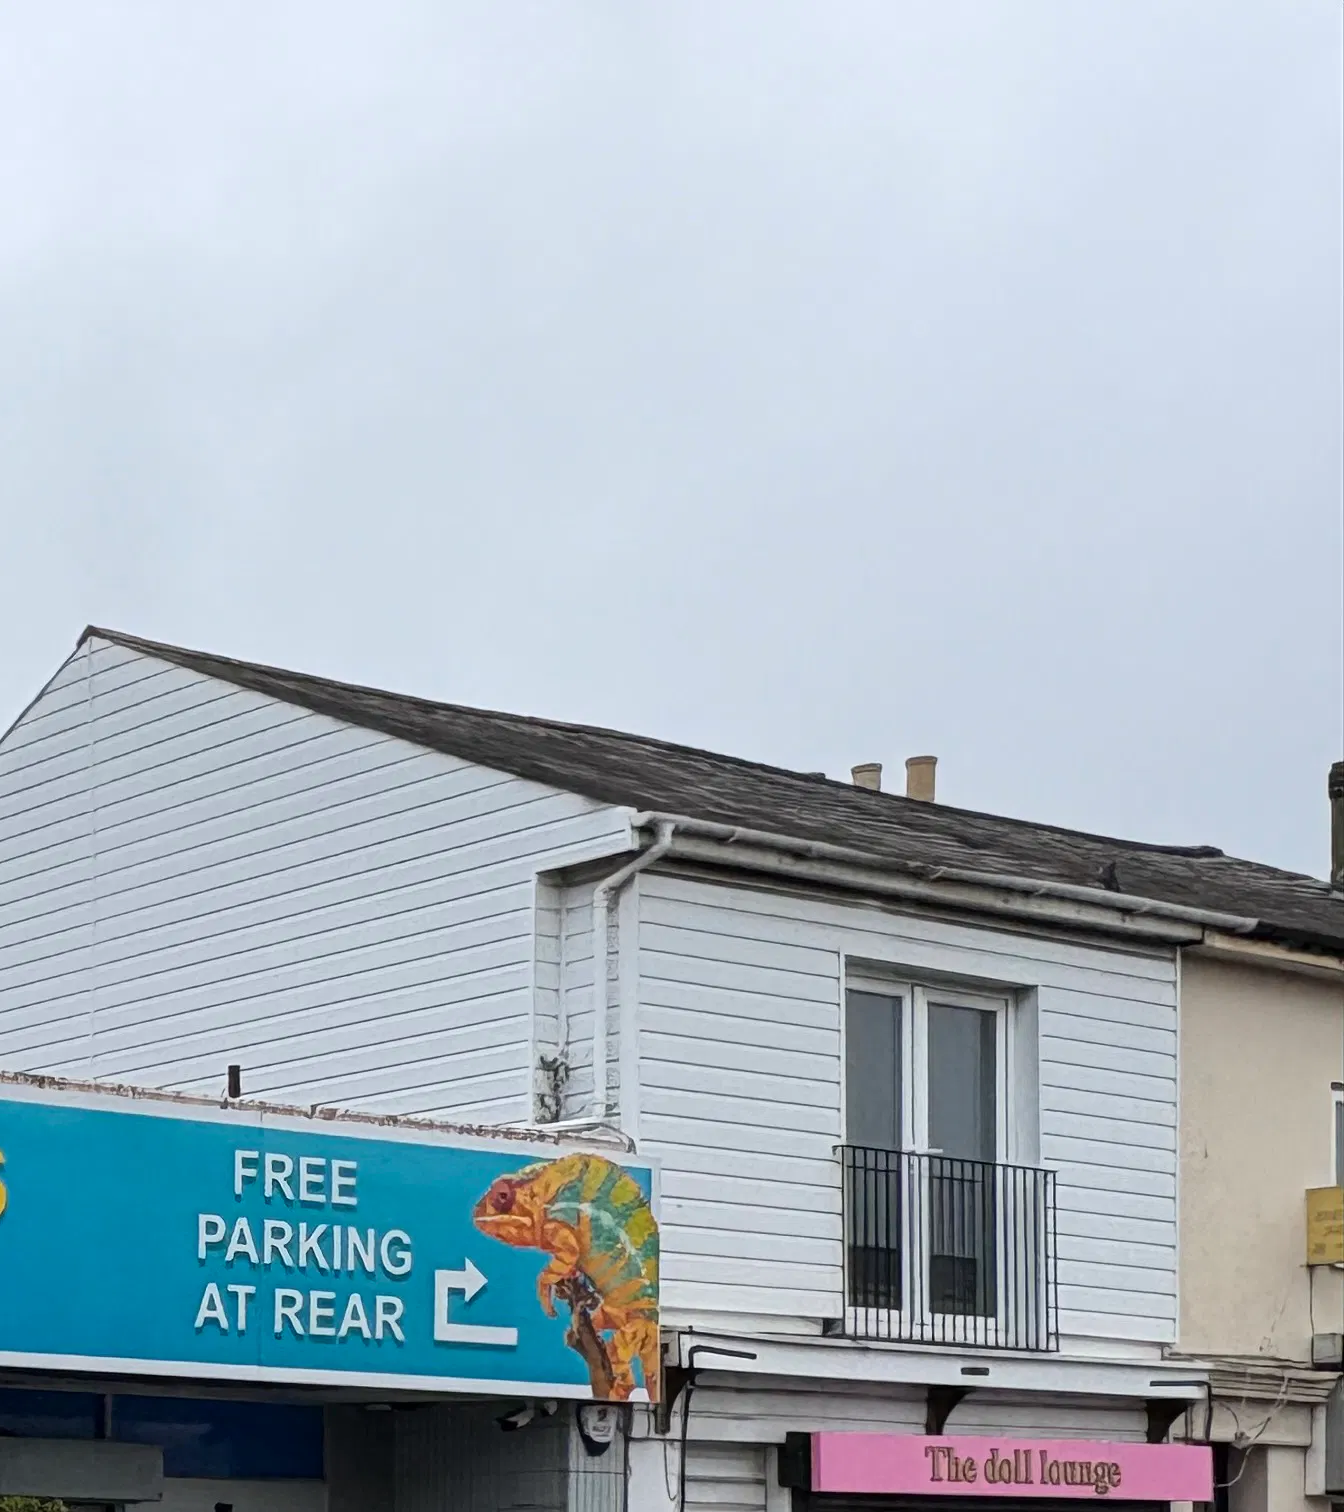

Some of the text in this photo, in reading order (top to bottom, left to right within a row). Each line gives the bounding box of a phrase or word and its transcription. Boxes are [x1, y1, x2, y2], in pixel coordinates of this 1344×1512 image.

[234, 1149, 358, 1206] FREE
[197, 1213, 412, 1276] PARKING
[194, 1282, 406, 1342] AT REAR
[924, 1446, 1121, 1494] The doll lounge
